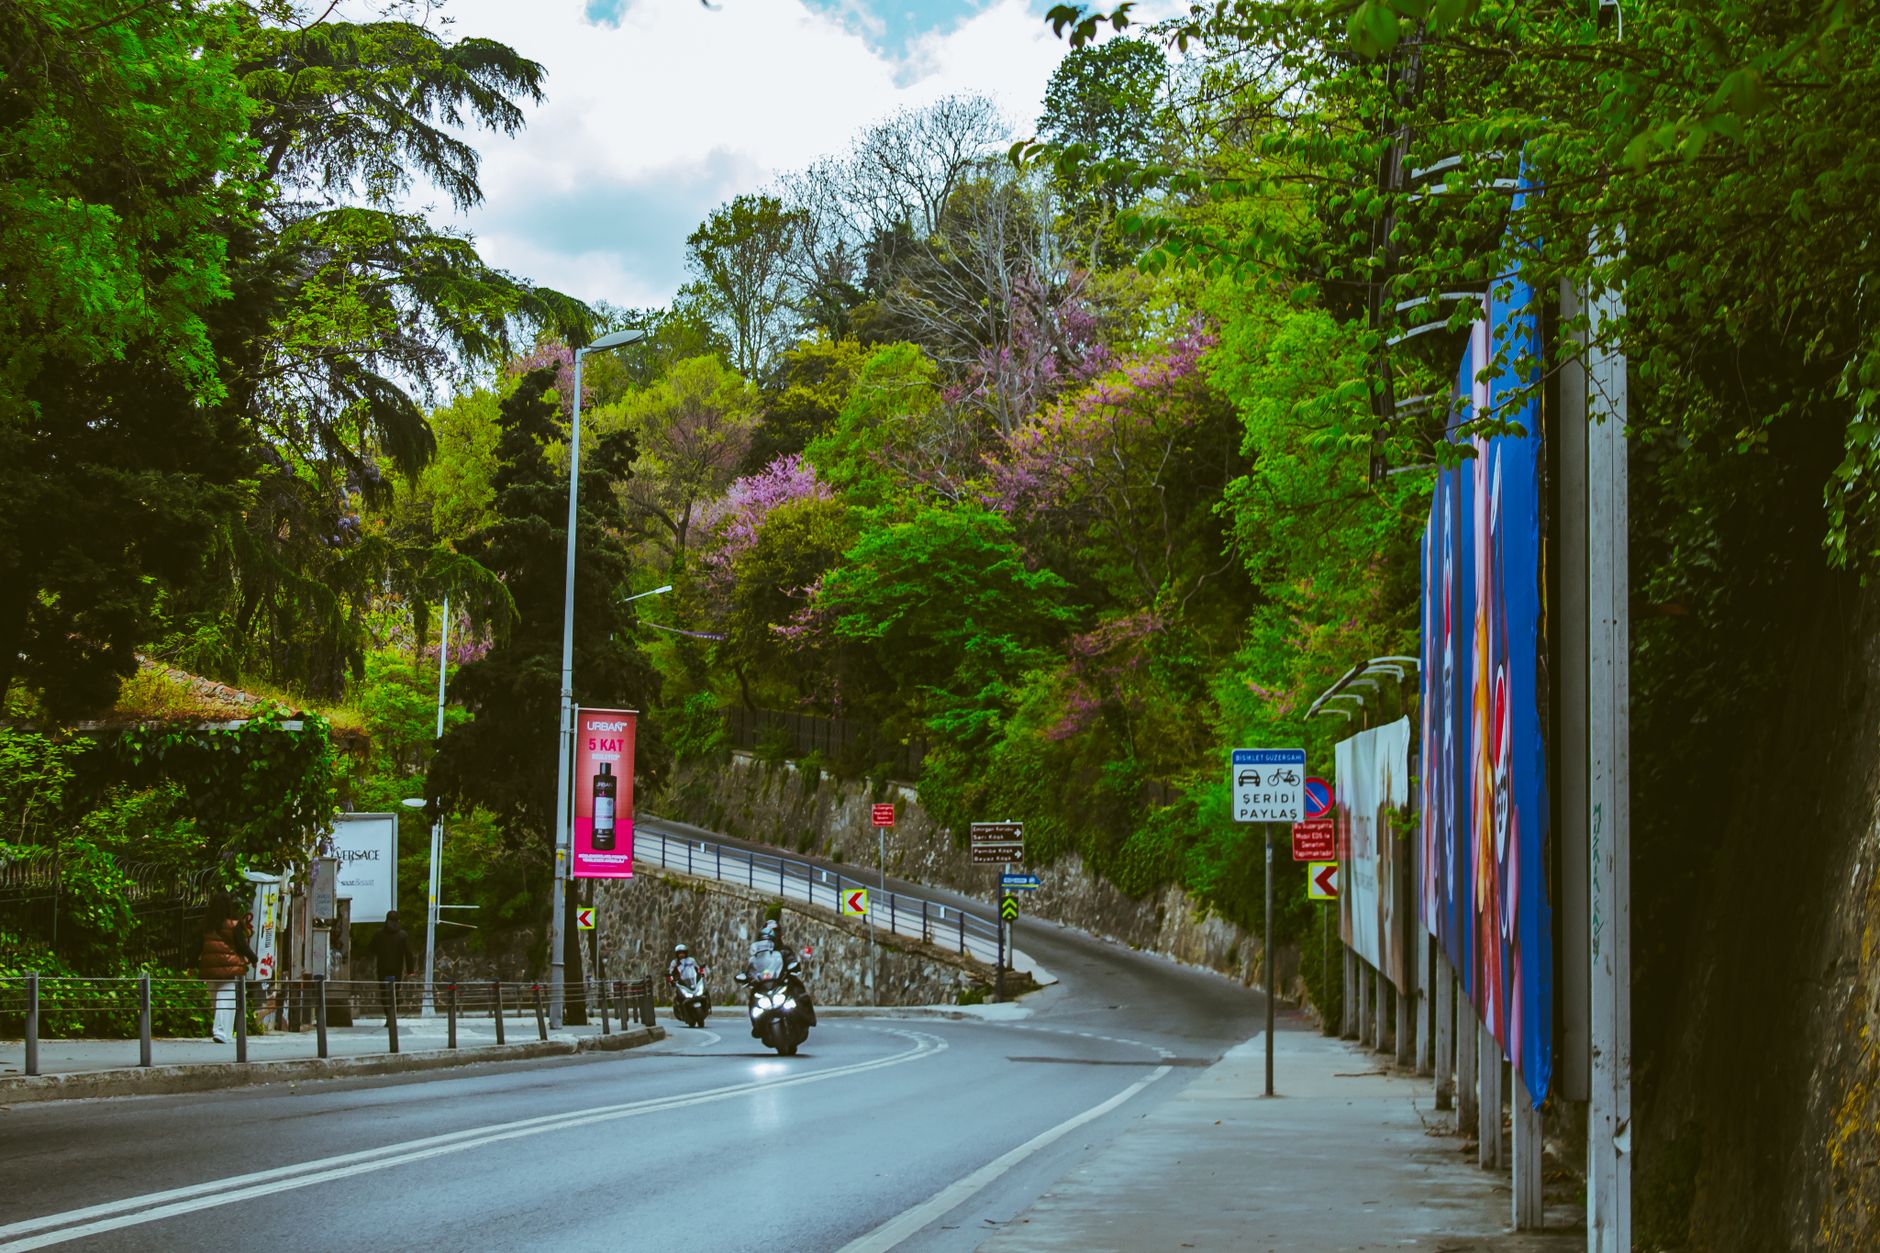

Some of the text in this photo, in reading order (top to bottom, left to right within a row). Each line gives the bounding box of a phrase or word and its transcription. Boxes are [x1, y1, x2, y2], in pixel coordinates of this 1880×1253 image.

[587, 721, 623, 732] URBAN
[589, 739, 624, 752] 5 KAT
[1242, 791, 1295, 805] ŞERİDİ
[1240, 809, 1297, 820] PAYLAŞ
[337, 849, 381, 861] VERSACE
